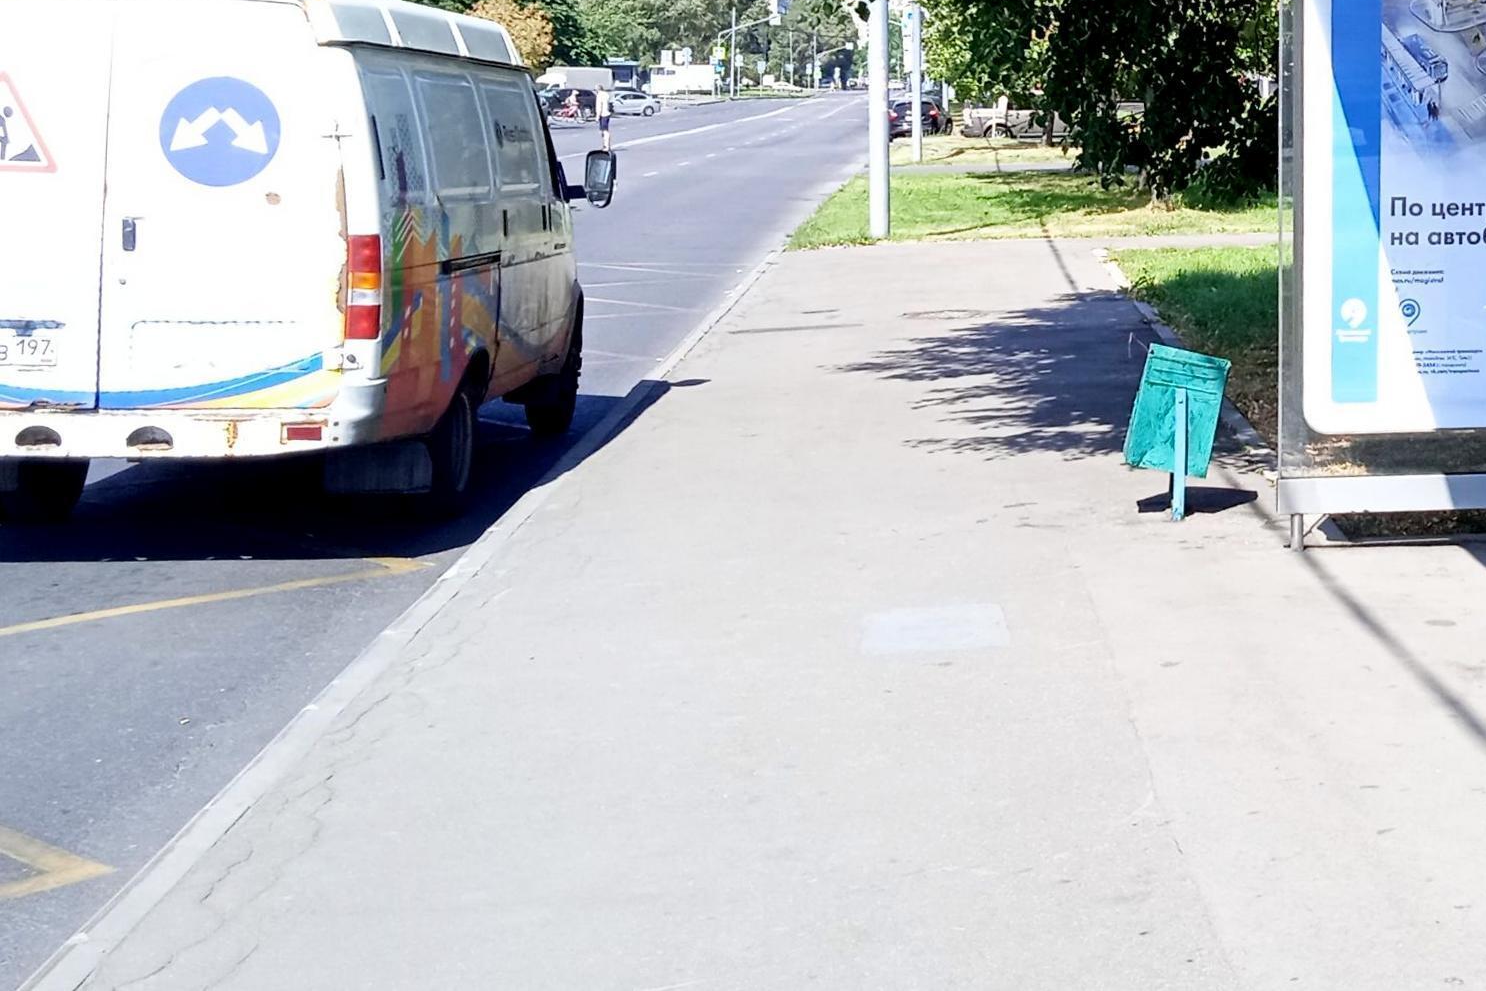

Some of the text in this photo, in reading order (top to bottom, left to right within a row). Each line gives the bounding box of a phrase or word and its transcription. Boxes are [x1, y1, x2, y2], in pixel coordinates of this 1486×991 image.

[1389, 196, 1423, 217] По
[1389, 230, 1419, 246] на
[16, 339, 51, 355] 197
